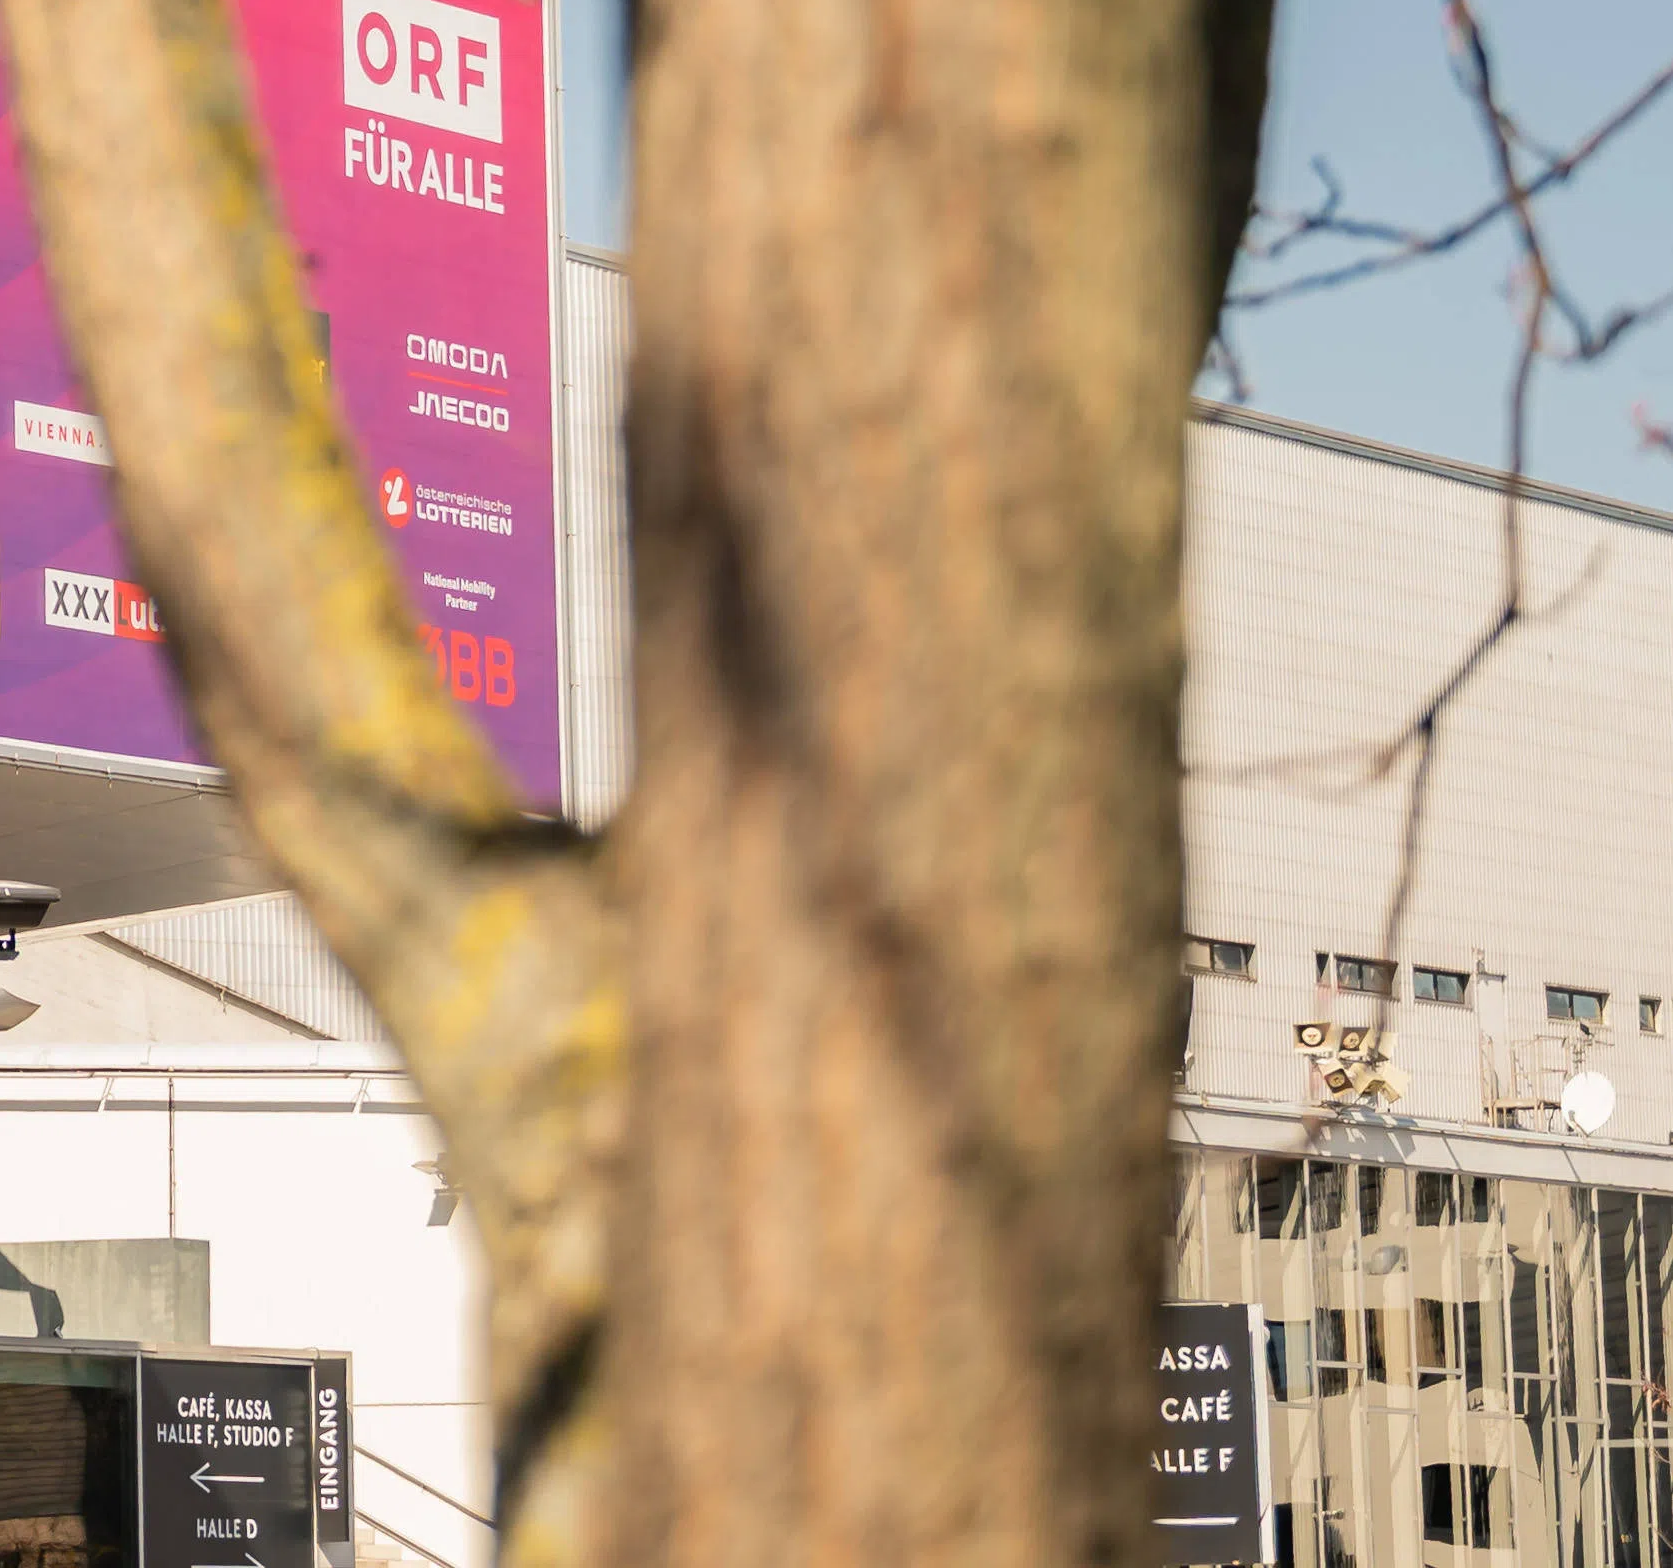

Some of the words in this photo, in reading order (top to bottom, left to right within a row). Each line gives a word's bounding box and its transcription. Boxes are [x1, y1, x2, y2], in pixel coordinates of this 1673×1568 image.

[357, 11, 488, 107] ORF
[344, 118, 414, 193] FÜR
[418, 148, 505, 215] ALLE
[407, 334, 508, 379] OMODA
[409, 391, 509, 433] JAECOO
[416, 484, 512, 516] österreichische
[416, 501, 512, 537] LOTTERIEN
[423, 572, 460, 591] National
[461, 578, 495, 600] Mobility
[445, 593, 478, 612] Partner
[52, 580, 166, 632] XXXLut
[1154, 1344, 1231, 1372] ASSA
[177, 1392, 220, 1422] CAFÉ,
[225, 1398, 272, 1421] KASSA
[1161, 1388, 1232, 1423] CAFÉ
[157, 1423, 203, 1445] HALLE
[223, 1425, 281, 1448] STUDIO
[285, 1427, 295, 1448] F
[319, 1388, 341, 1511] EINGANG
[1150, 1446, 1210, 1474] ALLE
[1218, 1446, 1236, 1474] F
[196, 1518, 242, 1539] HALLE
[246, 1518, 258, 1539] D
